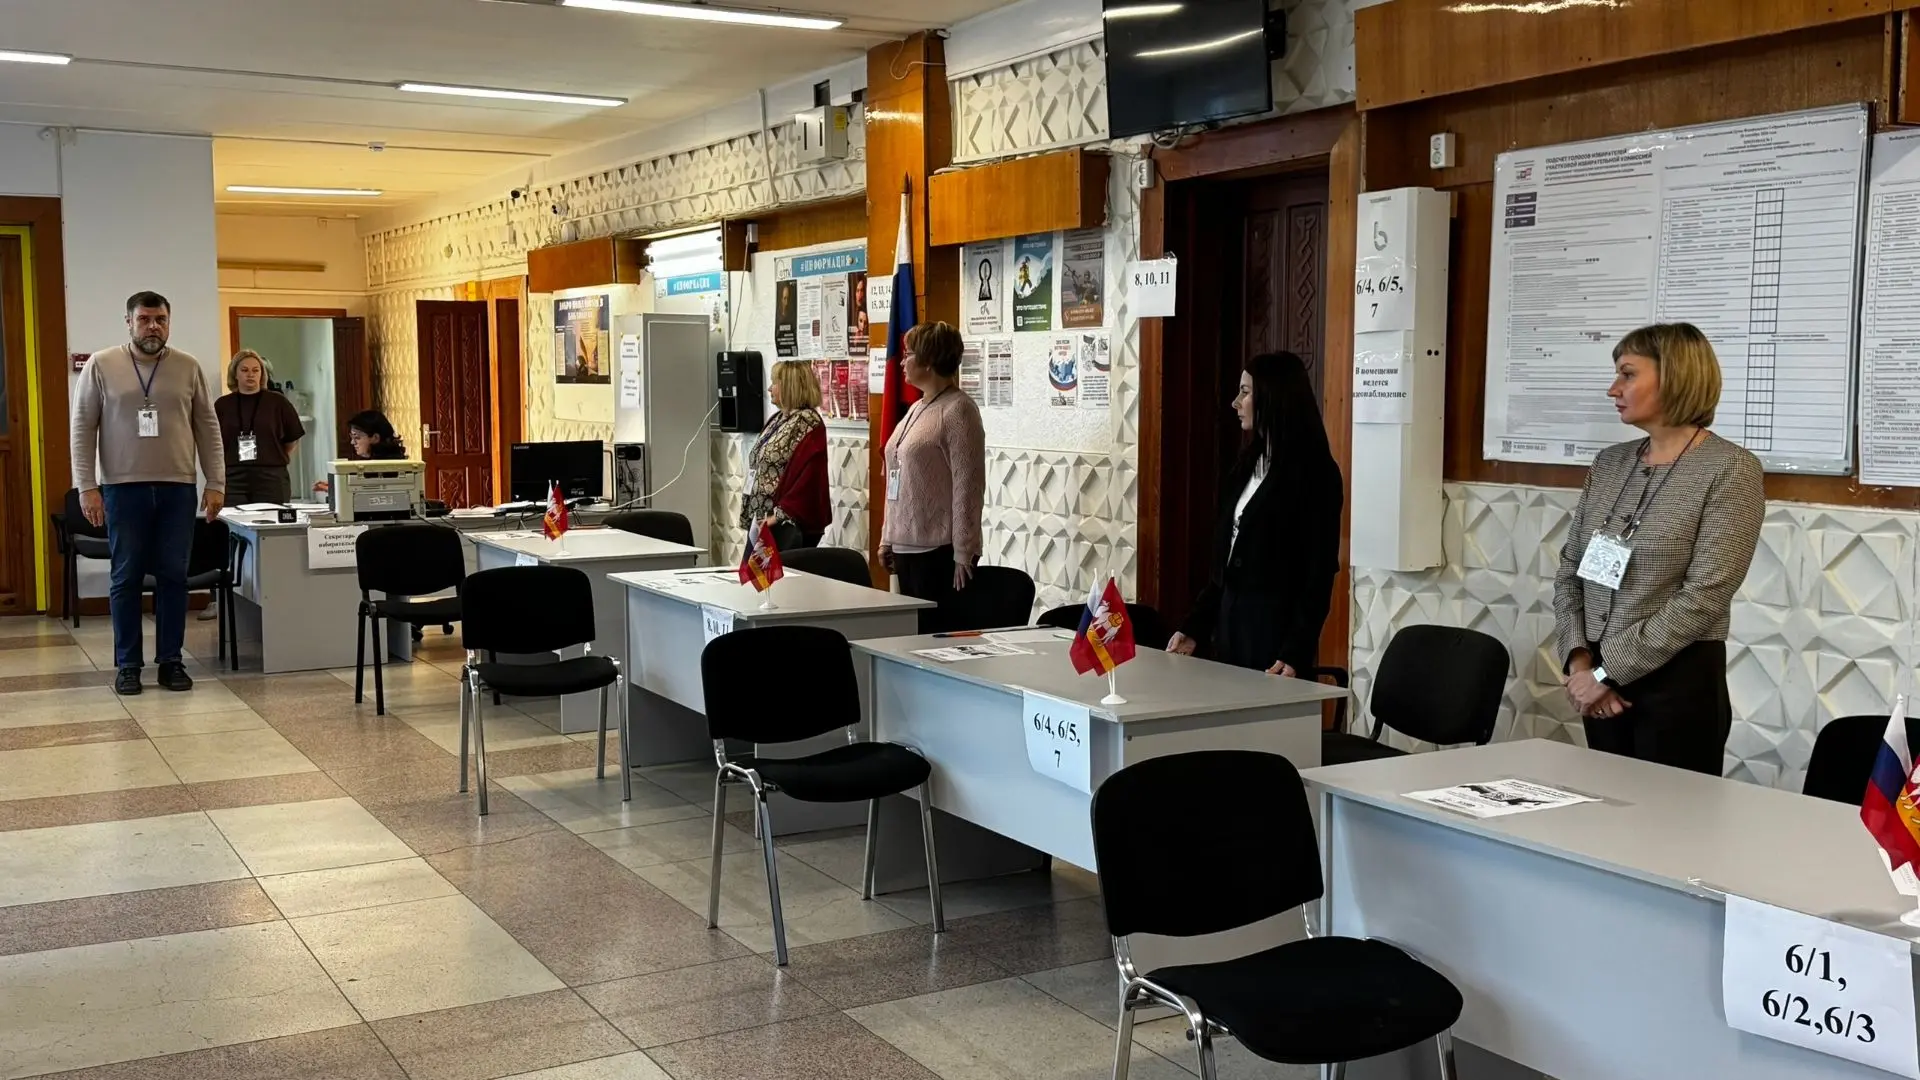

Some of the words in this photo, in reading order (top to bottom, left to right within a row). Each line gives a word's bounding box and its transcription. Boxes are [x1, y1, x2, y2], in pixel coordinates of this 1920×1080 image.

[1135, 272, 1142, 288] 8,
[1146, 272, 1157, 286] 10,
[1160, 271, 1169, 284] 11
[1356, 277, 1375, 296] 6/4,
[1378, 275, 1404, 294] 6/5,
[1371, 303, 1379, 318] 7
[1355, 367, 1360, 375] В
[1033, 712, 1055, 740] 6/4,
[1058, 720, 1081, 748] 6/5,
[1054, 749, 1061, 768] 7
[1785, 944, 1847, 992] 6/1,
[1762, 989, 1876, 1043] 6/2,6/3
